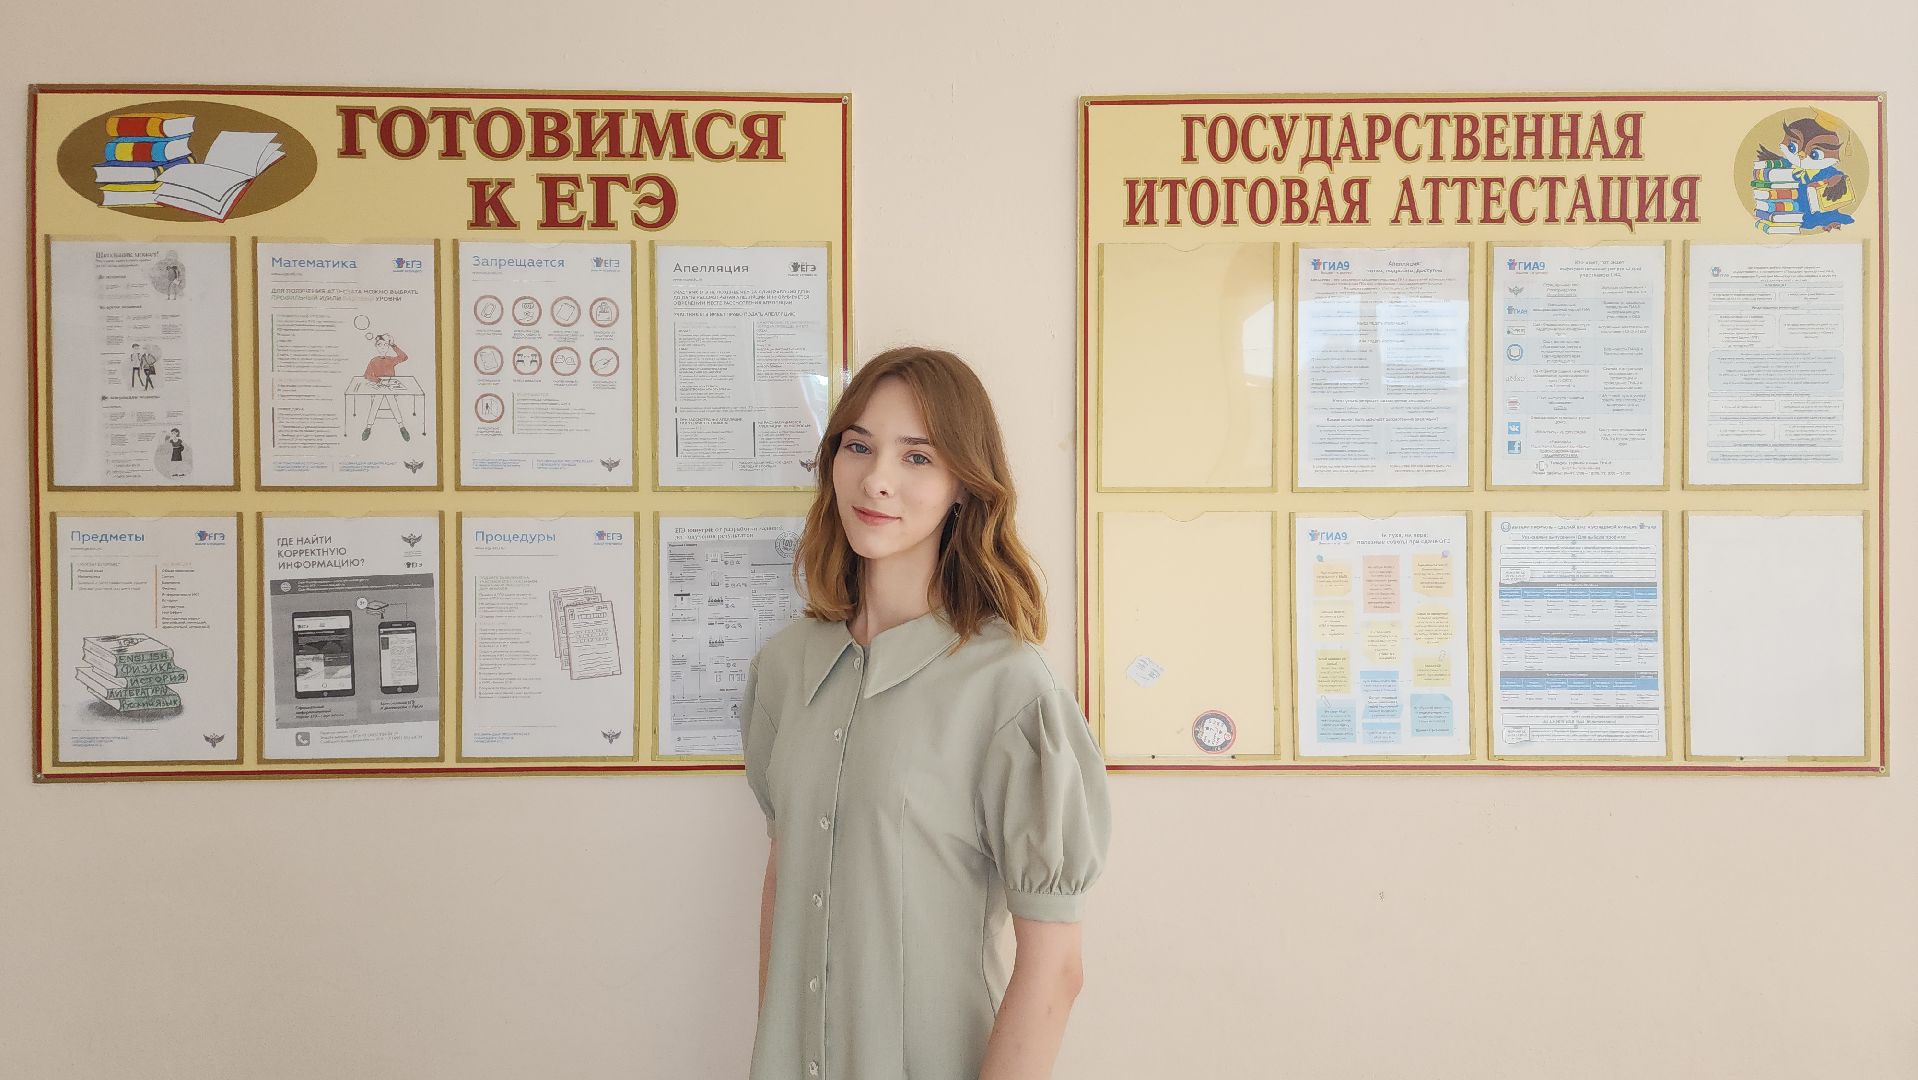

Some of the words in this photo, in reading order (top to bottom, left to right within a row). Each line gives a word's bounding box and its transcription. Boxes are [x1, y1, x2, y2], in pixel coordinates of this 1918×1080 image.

[336, 105, 786, 163] ГОТОВИМСЯ
[1181, 112, 1645, 173] ГОСУДАРСТВЕННАЯ
[466, 177, 520, 231] К
[536, 173, 679, 231] ЕГЭ
[1123, 176, 1372, 227] ИТОГОВАЯ
[1389, 174, 1702, 233] АТТЕСТАЦИЯ
[271, 257, 358, 269] Математика
[405, 259, 422, 268] ЕГЭ
[472, 255, 565, 269] Запрещается
[603, 259, 620, 268] ЕГЭ
[800, 264, 817, 272] ЕГЭ
[1322, 260, 1350, 271] ГИА9
[1518, 261, 1546, 271] ГИА9
[672, 262, 749, 275] Апелляция
[71, 530, 145, 544] Предметы
[277, 537, 294, 547] ГДЕ
[296, 534, 332, 546] НАЙТИ
[475, 530, 556, 544] Процедуры
[606, 532, 623, 541] ЕГЭ
[1320, 531, 1348, 541] ГИА9
[277, 547, 347, 558] КОРРЕКТНУЮ
[278, 558, 365, 570] ИНФОРМАЦИЮ?
[118, 651, 168, 663] ENGLISH
[120, 662, 173, 674] ФИЗИКА
[129, 674, 185, 688] ИСТОРИЯ
